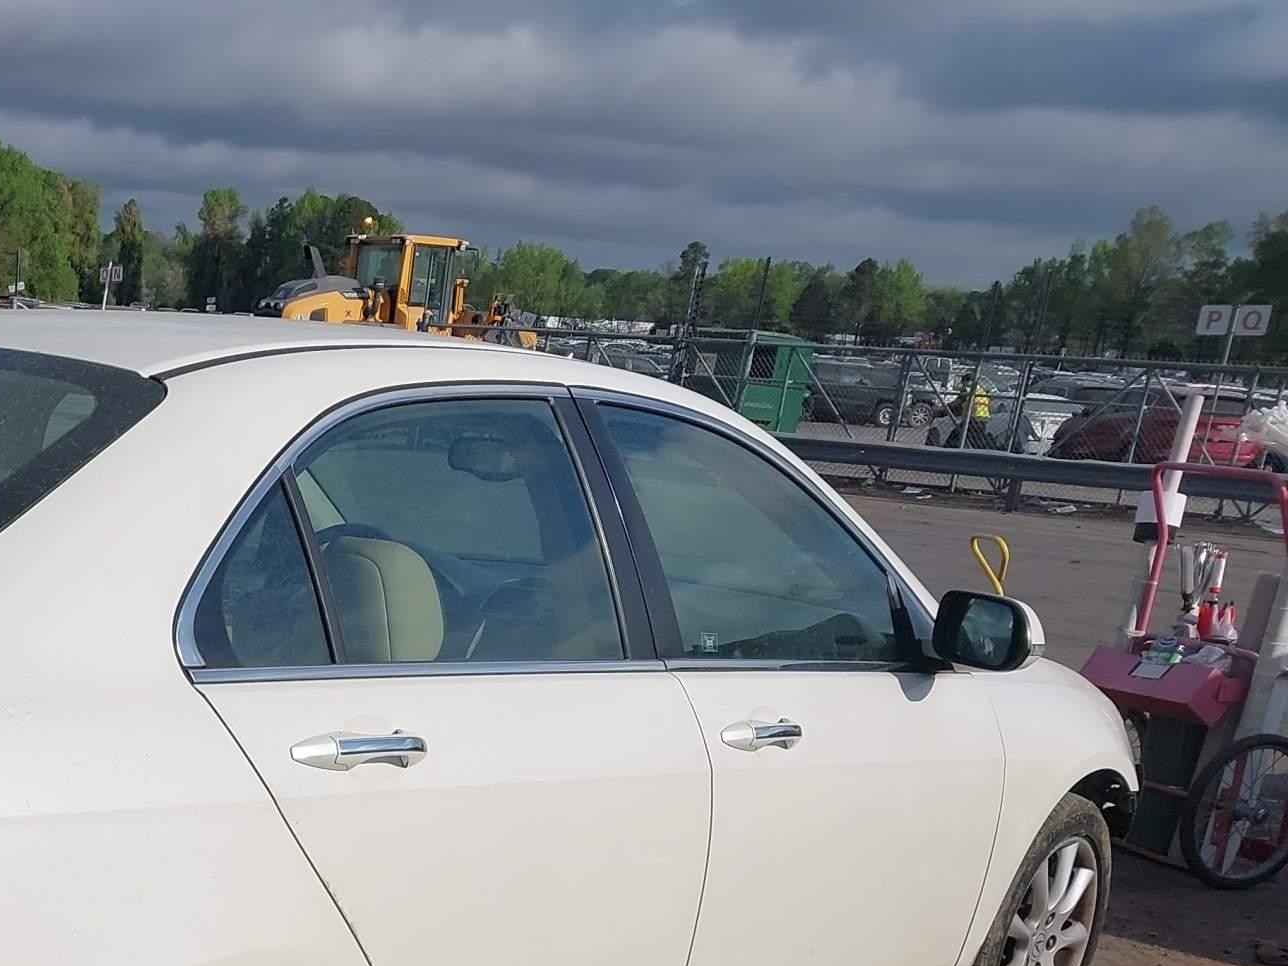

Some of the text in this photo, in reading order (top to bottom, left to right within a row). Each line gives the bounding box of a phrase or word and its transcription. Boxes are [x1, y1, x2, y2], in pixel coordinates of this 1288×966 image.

[113, 267, 121, 280] N
[1205, 311, 1223, 330] P
[1242, 311, 1262, 330] Q
